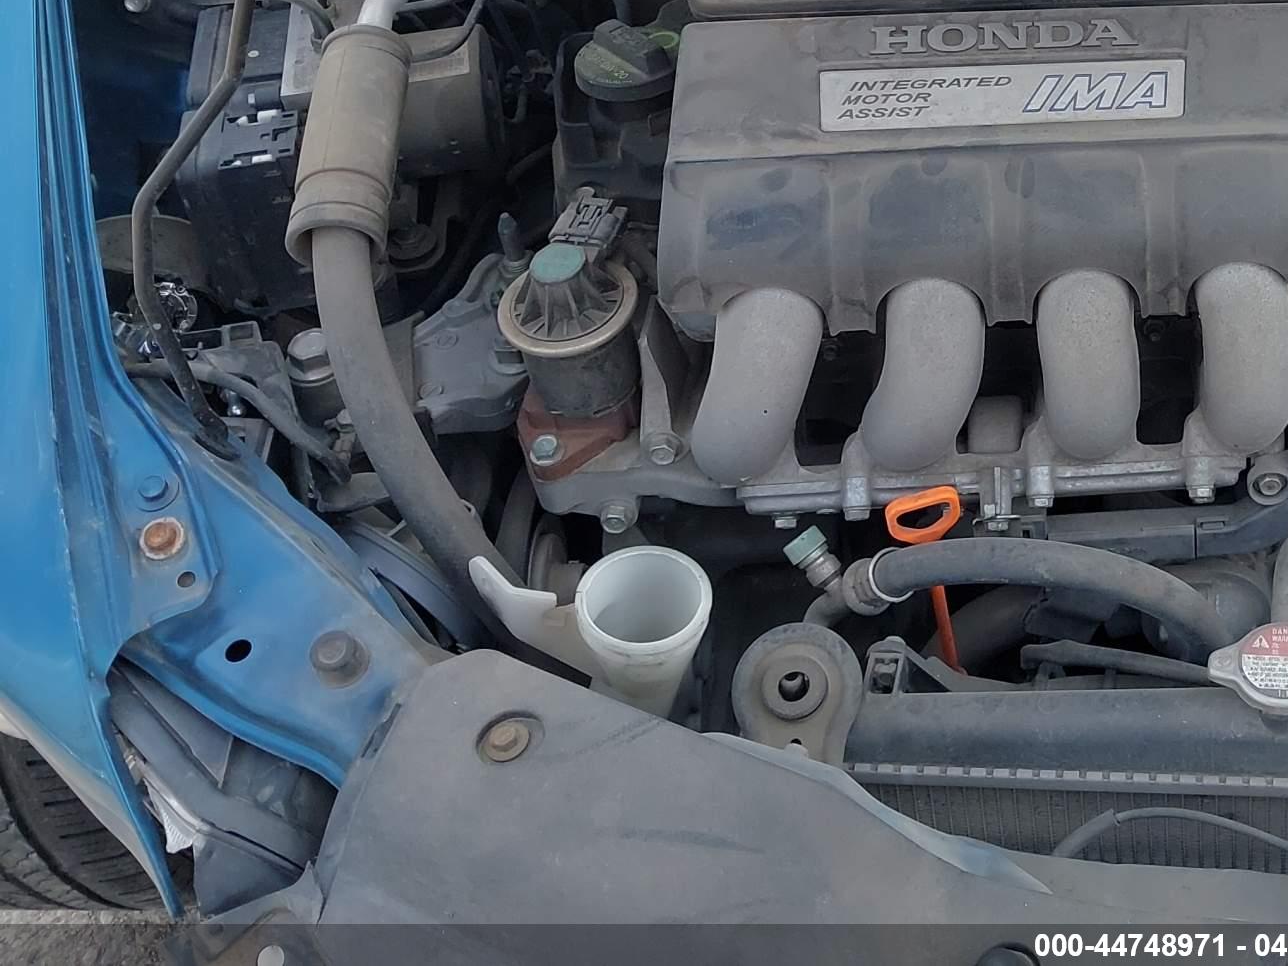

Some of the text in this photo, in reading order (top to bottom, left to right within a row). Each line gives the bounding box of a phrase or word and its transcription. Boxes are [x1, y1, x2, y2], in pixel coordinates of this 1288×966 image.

[869, 18, 1141, 57] HONDA
[841, 92, 933, 107] MOTOR
[849, 71, 1169, 114] INTEGRATED IMA
[837, 106, 931, 121] ASSIST
